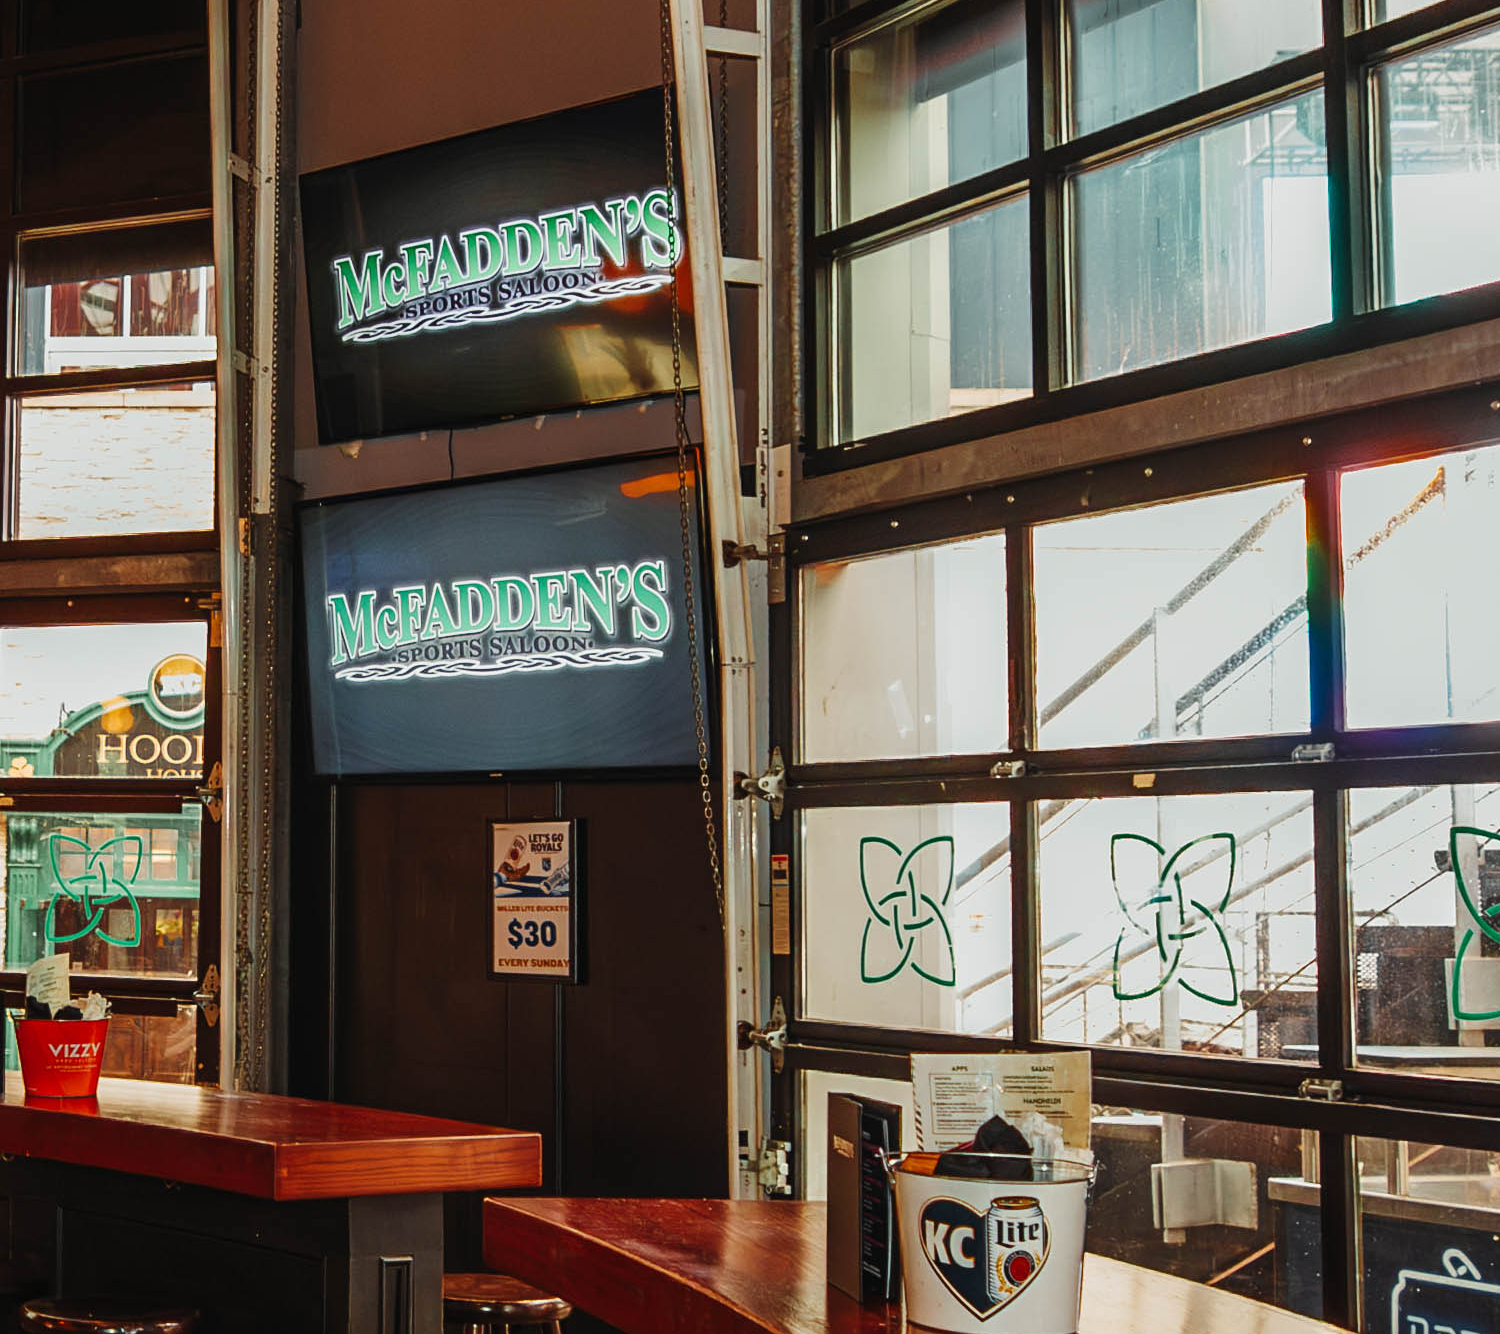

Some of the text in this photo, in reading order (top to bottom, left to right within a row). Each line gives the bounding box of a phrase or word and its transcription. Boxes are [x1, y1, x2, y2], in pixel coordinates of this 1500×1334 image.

[333, 186, 684, 330] McFADDEN'S
[404, 271, 599, 320] SPORTS SALOON
[328, 559, 673, 667] McFADDEN'S
[398, 634, 590, 664] SPORTS SALOON
[529, 833, 564, 843] LET'S GO
[531, 843, 562, 852] ROYALS
[508, 918, 557, 950] $30
[498, 958, 571, 968] EVERY SUNDAY
[48, 1043, 100, 1058] VIZZY
[924, 1219, 976, 1269] KC
[995, 1219, 1040, 1249] Lite
